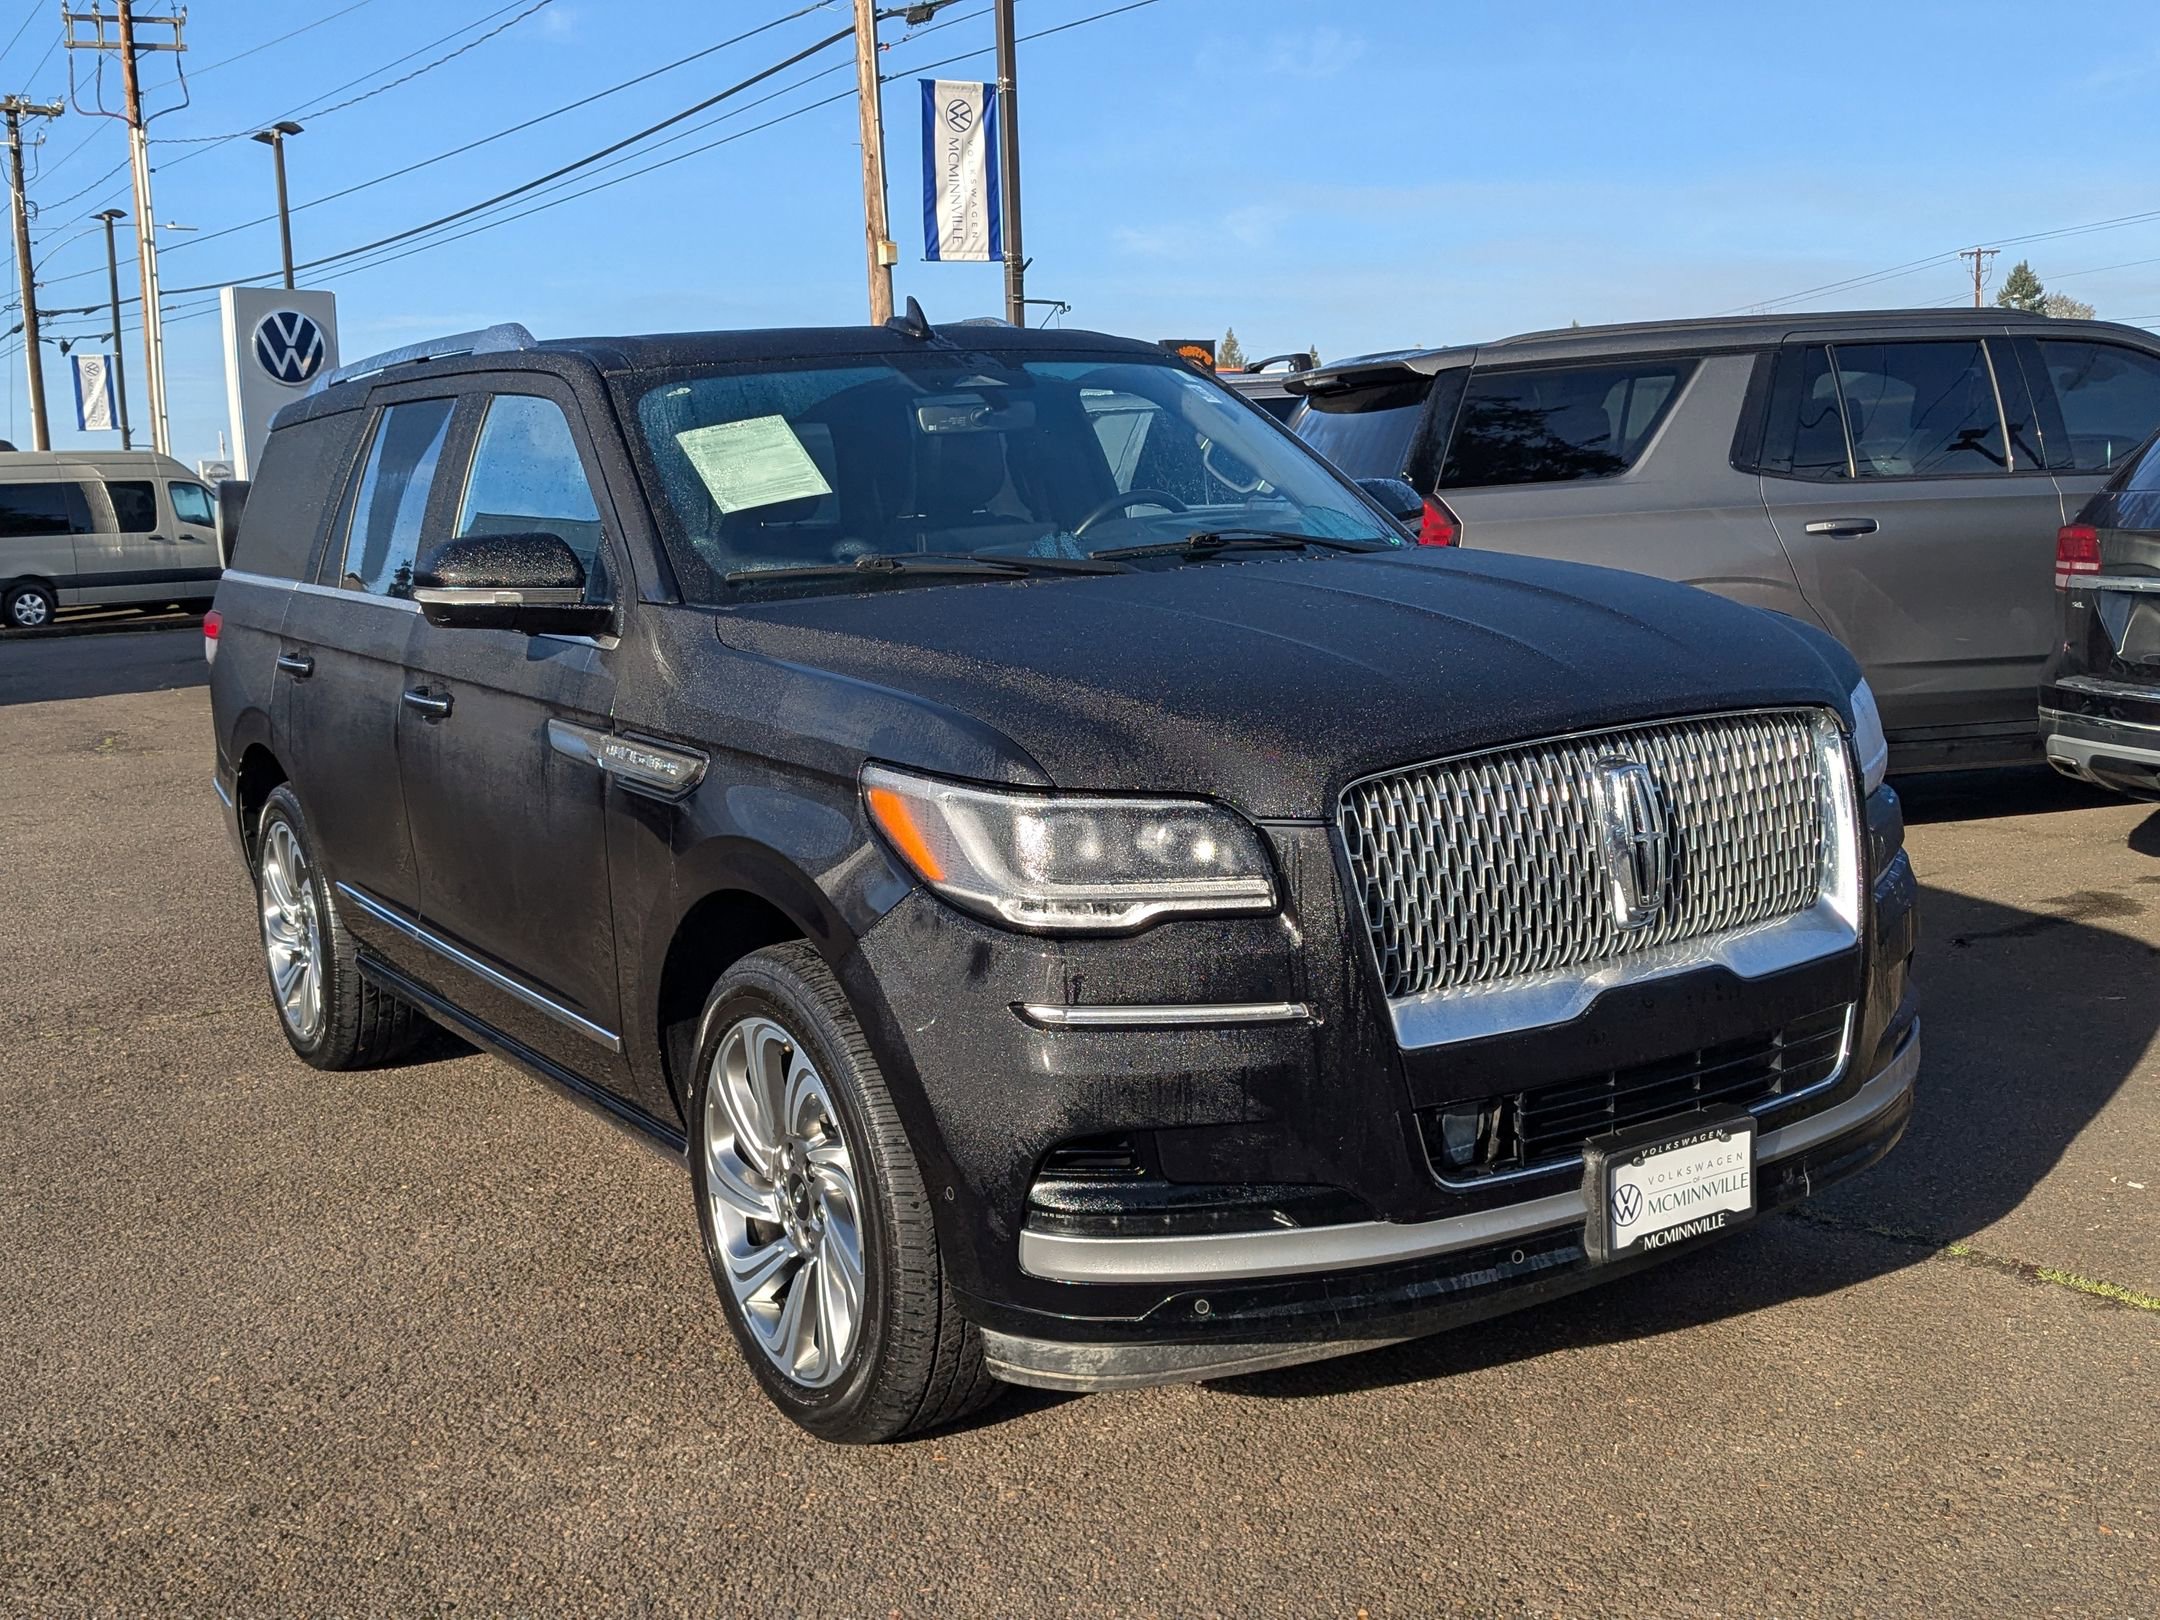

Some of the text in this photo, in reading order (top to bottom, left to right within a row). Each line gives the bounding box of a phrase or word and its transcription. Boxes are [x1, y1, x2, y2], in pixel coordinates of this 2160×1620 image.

[948, 137, 963, 244] MCMINNVILLE
[967, 139, 978, 239] VOLKSWAGEN
[1641, 1129, 1724, 1158] VOLKSWAGEN
[1648, 1152, 1744, 1185] VOLKSWAGEN
[1648, 1172, 1749, 1216] MCMINNVILLE
[1643, 1212, 1727, 1251] MCMINNVILLE
